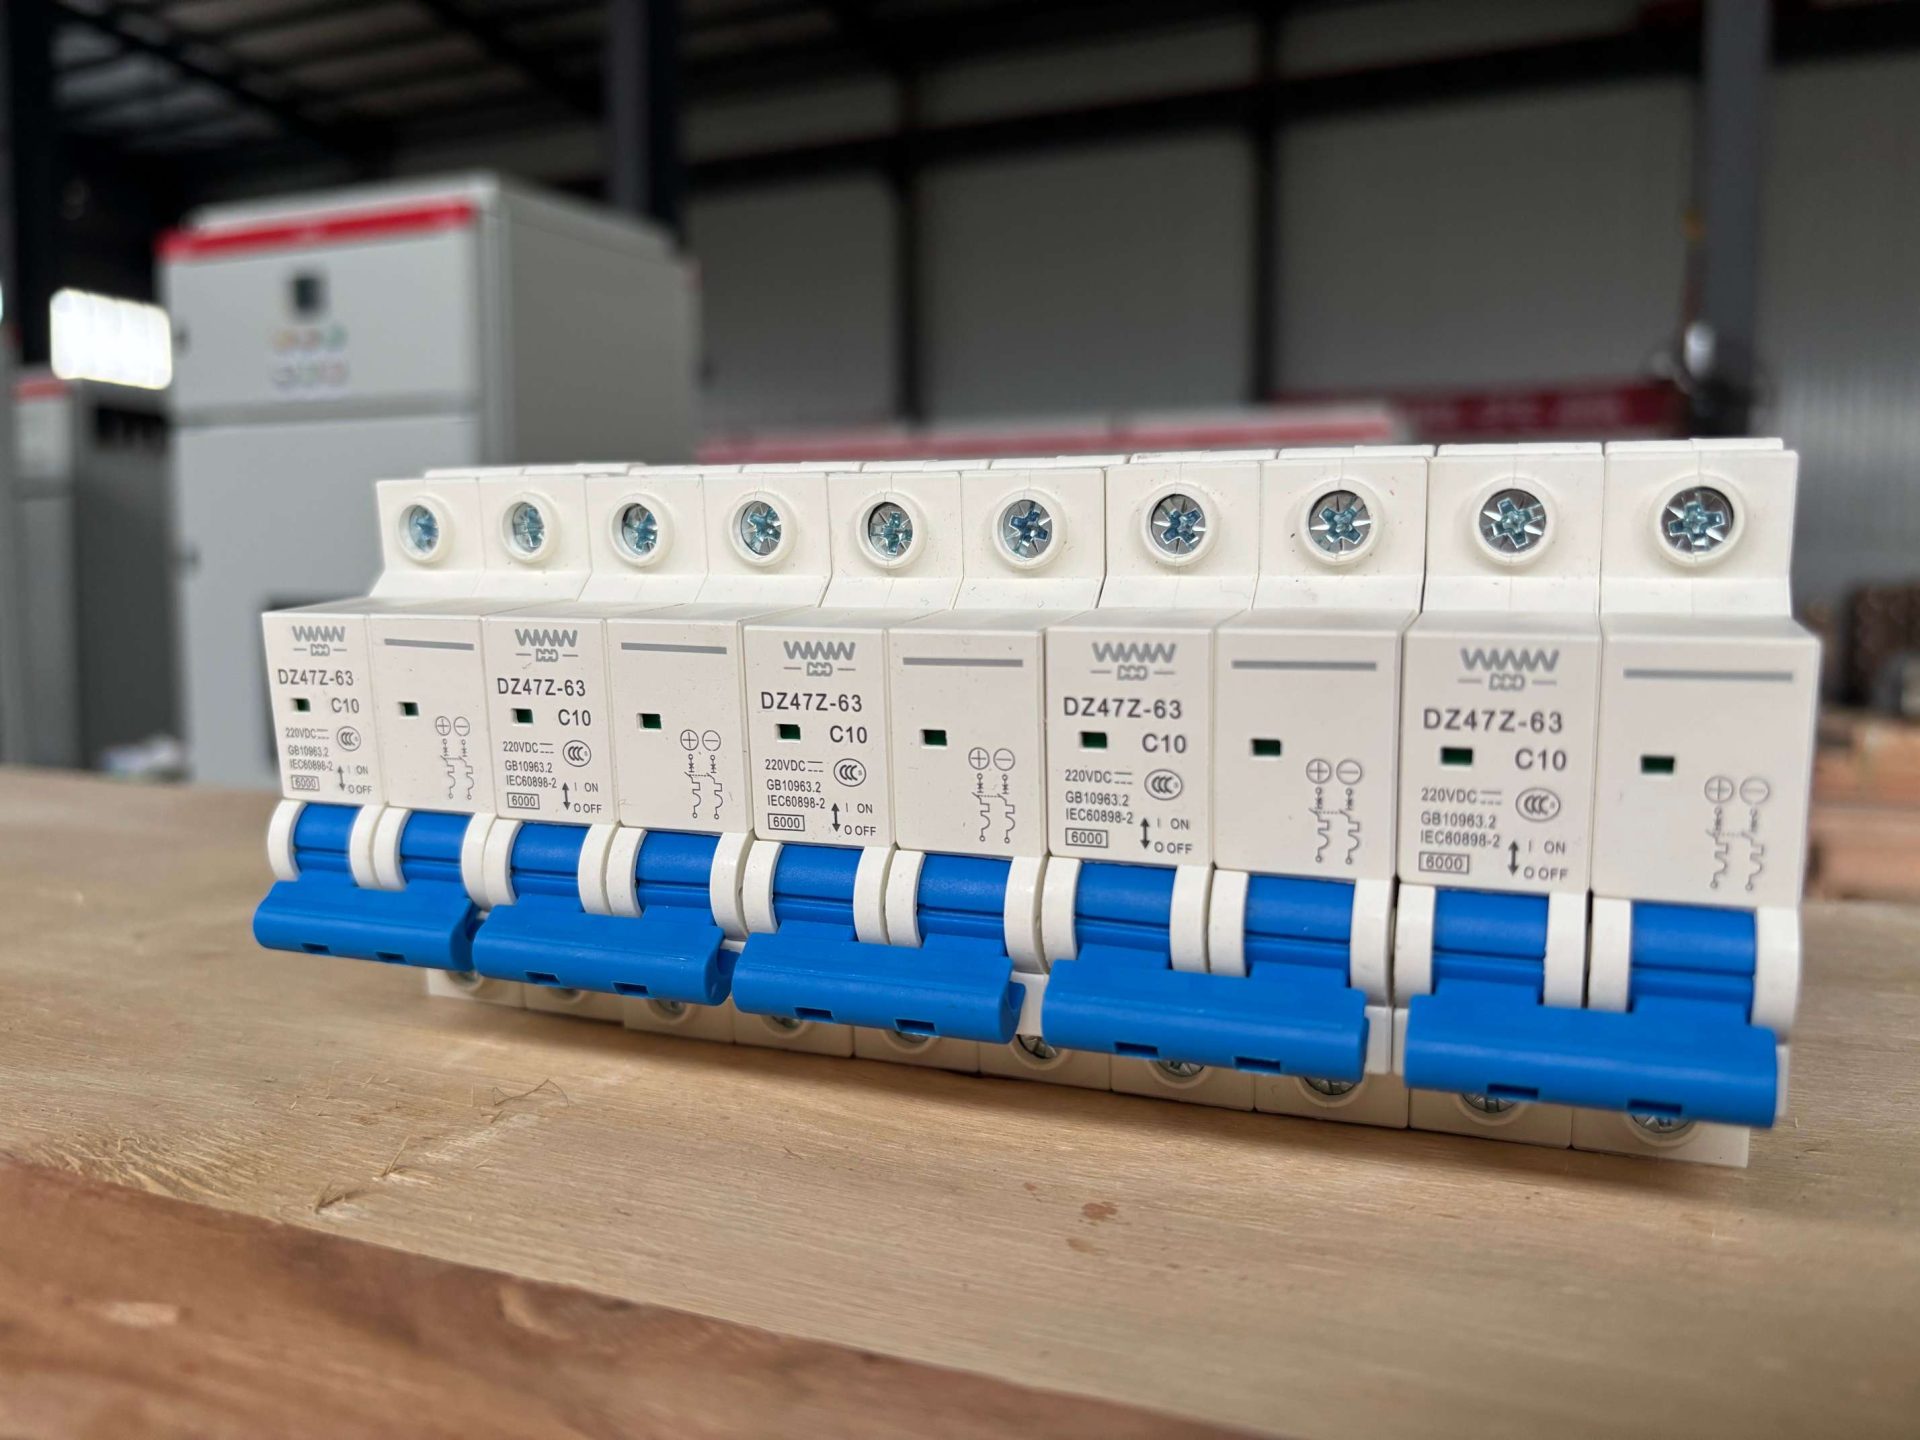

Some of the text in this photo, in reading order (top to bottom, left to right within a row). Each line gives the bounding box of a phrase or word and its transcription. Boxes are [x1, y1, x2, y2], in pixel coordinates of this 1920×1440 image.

[278, 669, 354, 686] DZ47Z-63
[497, 678, 586, 697] DZ47Z-63
[331, 698, 359, 713] C10
[761, 692, 863, 712] DZ47Z-63
[1064, 697, 1182, 720] DZ47Z-63
[558, 709, 591, 726] C10
[1423, 708, 1563, 733] DZ47Z-63
[286, 727, 316, 739] 220VDC
[830, 725, 868, 744] C10
[503, 741, 538, 753] 220VDC
[1142, 733, 1186, 753] C10
[505, 760, 552, 773] GB10963.2
[765, 759, 806, 772] 220VDC
[1514, 748, 1566, 771] C10
[356, 765, 368, 774] ON
[1065, 769, 1112, 784] 220VDC
[295, 777, 316, 788] 6000
[506, 774, 557, 788] IEC60898-2
[584, 782, 598, 792] ON
[767, 779, 821, 793] GB10963.2
[356, 785, 372, 795] OFF
[1421, 787, 1477, 803] 220VDC
[512, 795, 535, 807] 6000
[768, 795, 825, 809] IEC60898-2
[1066, 791, 1129, 806] GB10963.2
[583, 803, 602, 814] OFF
[857, 803, 873, 814] ON
[1066, 807, 1133, 824] IEC60898-2
[773, 816, 800, 829] 6000
[1170, 818, 1189, 830] ON
[1420, 811, 1496, 829] GB10963.2
[855, 825, 877, 836] OFF
[1071, 831, 1102, 844] 6000
[1420, 830, 1500, 848] IEC60898-2
[1167, 842, 1192, 854] OFF
[1544, 840, 1565, 854] ON
[1426, 855, 1463, 871] 6000
[1537, 868, 1568, 880] OFF
